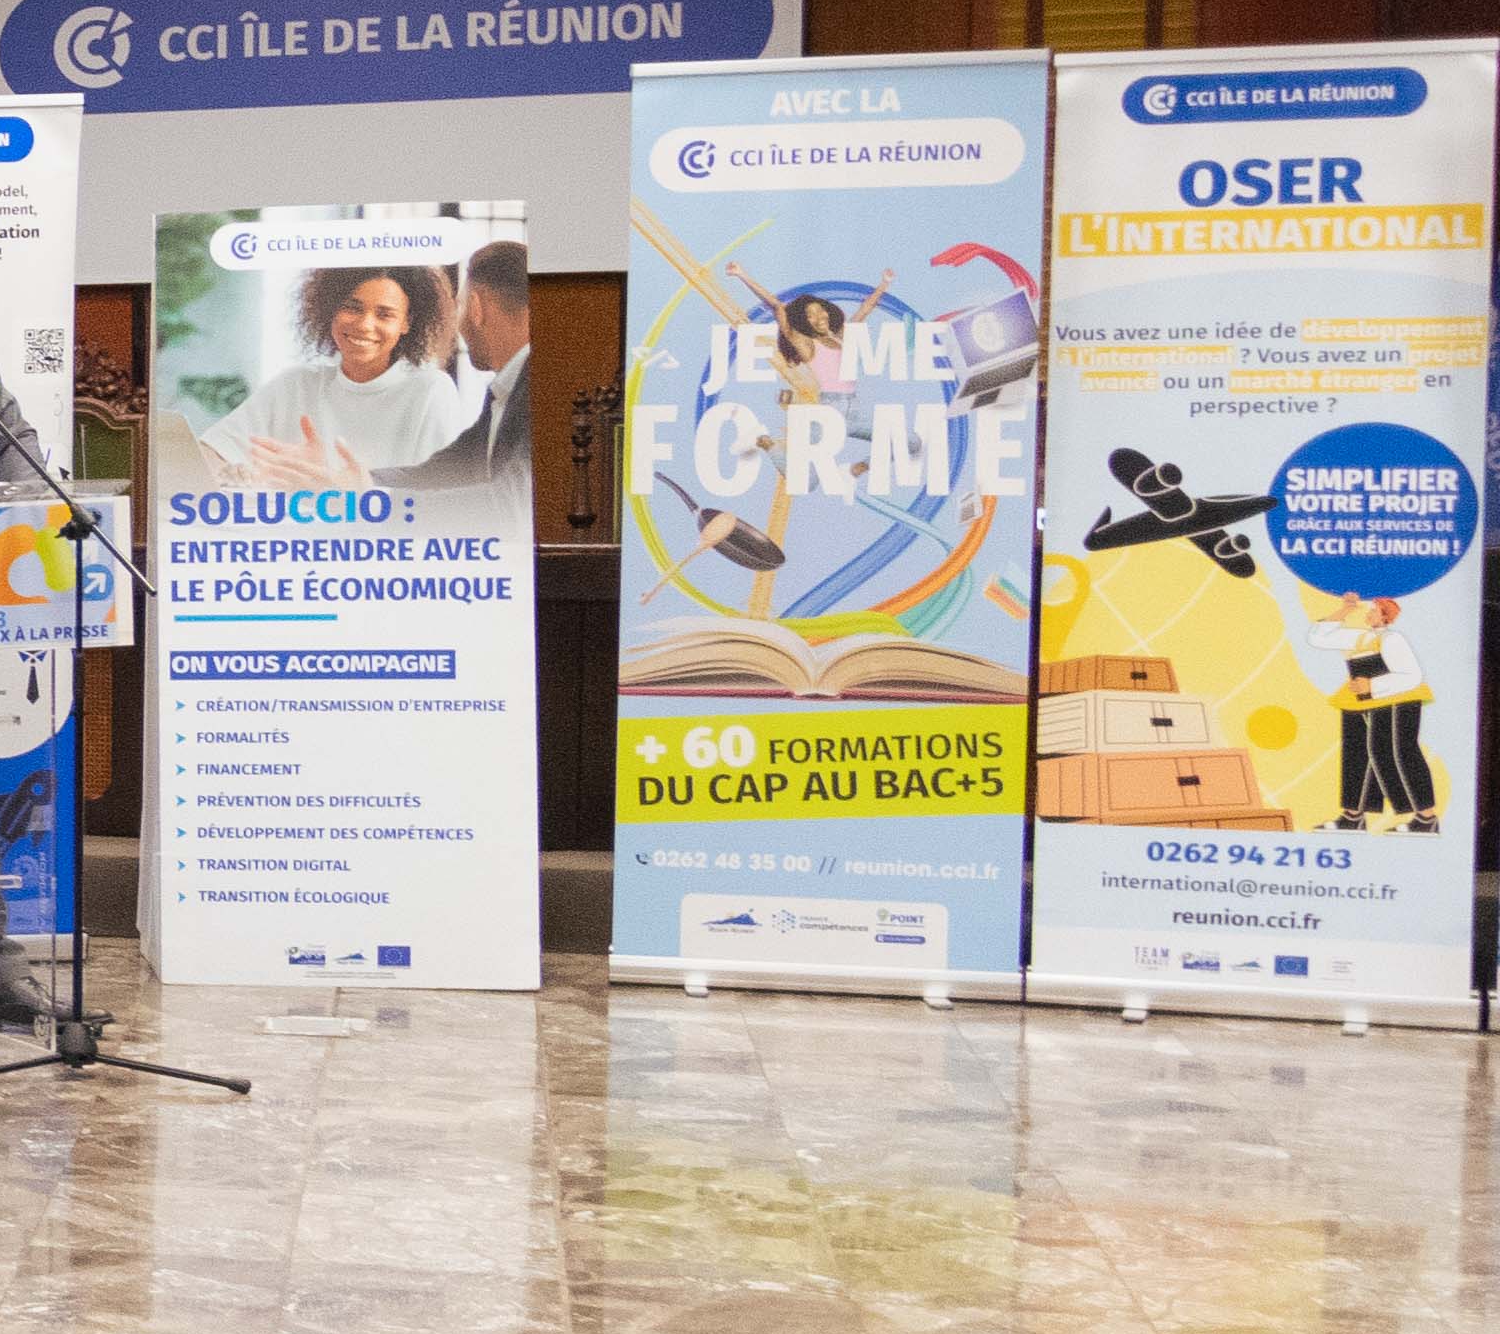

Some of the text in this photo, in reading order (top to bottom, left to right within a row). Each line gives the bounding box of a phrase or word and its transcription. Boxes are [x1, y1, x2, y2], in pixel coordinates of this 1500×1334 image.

[159, 25, 227, 62] CCI
[239, 12, 308, 57] ÎLE
[324, 17, 381, 54] DE
[397, 14, 453, 51] LA
[770, 89, 901, 116] AVEC LA
[1186, 83, 1395, 107] CCI ÎLE DE LA RÉUNION
[730, 141, 981, 166] CCI ÎLE DE LA RÉUNION
[1179, 157, 1363, 207] OSER
[267, 233, 442, 251] CCI ÎLE DE LA RÉUNION
[1069, 212, 1477, 253] L'INTERNATIONAL
[1054, 325, 1107, 341] Vous
[1113, 328, 1160, 341] avez
[1168, 327, 1208, 339] une
[1216, 322, 1262, 339] idée
[1270, 323, 1296, 338] de
[702, 322, 957, 396] JE ME
[1257, 348, 1310, 363] Vous
[1317, 350, 1367, 363] avez
[1375, 350, 1401, 362] un
[1163, 377, 1189, 389] ou
[1198, 377, 1224, 389] un
[1424, 374, 1452, 387] en
[1190, 396, 1319, 417] perspective
[631, 402, 1028, 499] FORME
[1286, 468, 1458, 492] SIMPLIFIER
[170, 490, 392, 525] SOLUCCIO
[1285, 494, 1458, 514] VOTRE PROJET
[1287, 517, 1453, 532] GRÂCE AUX SERVICES DE
[171, 537, 500, 563] ENTREPRENDRE AVEC
[1281, 534, 1448, 555] LA CCI RÉUNION
[171, 571, 512, 604] LE PÔLE ÉCONOMIQUE
[15, 626, 25, 641] À
[30, 628, 49, 640] LA
[54, 624, 108, 640] PRSSE
[171, 655, 450, 673] ON VOUS ACCOMPAGNE
[196, 698, 505, 712] CRÉATION/TRANSMISSION D'ENTREPRISE
[197, 729, 290, 743] FORMALITÉS
[636, 724, 1003, 769] + 60 FORMATIONS
[197, 764, 300, 775] FINANCEMENT
[638, 767, 1003, 805] DU CAP AU BAC+5
[197, 792, 421, 808] PRÉVENTION DES DIFFICULTÉS
[197, 824, 474, 840] DÉVELOPPEMENT DES COMPÉTENCES
[198, 859, 350, 871] TRANSITION DIGITAL
[1147, 842, 1351, 869] 0262 94 21 63
[845, 859, 1000, 880] reunion.cci.fr
[1102, 871, 1398, 900] international@reunion.cci.fr
[198, 888, 389, 905] TRANSITION ÉCOLOGIQUE
[890, 915, 924, 924] POINT
[1173, 909, 1321, 929] reunion.cci.fr
